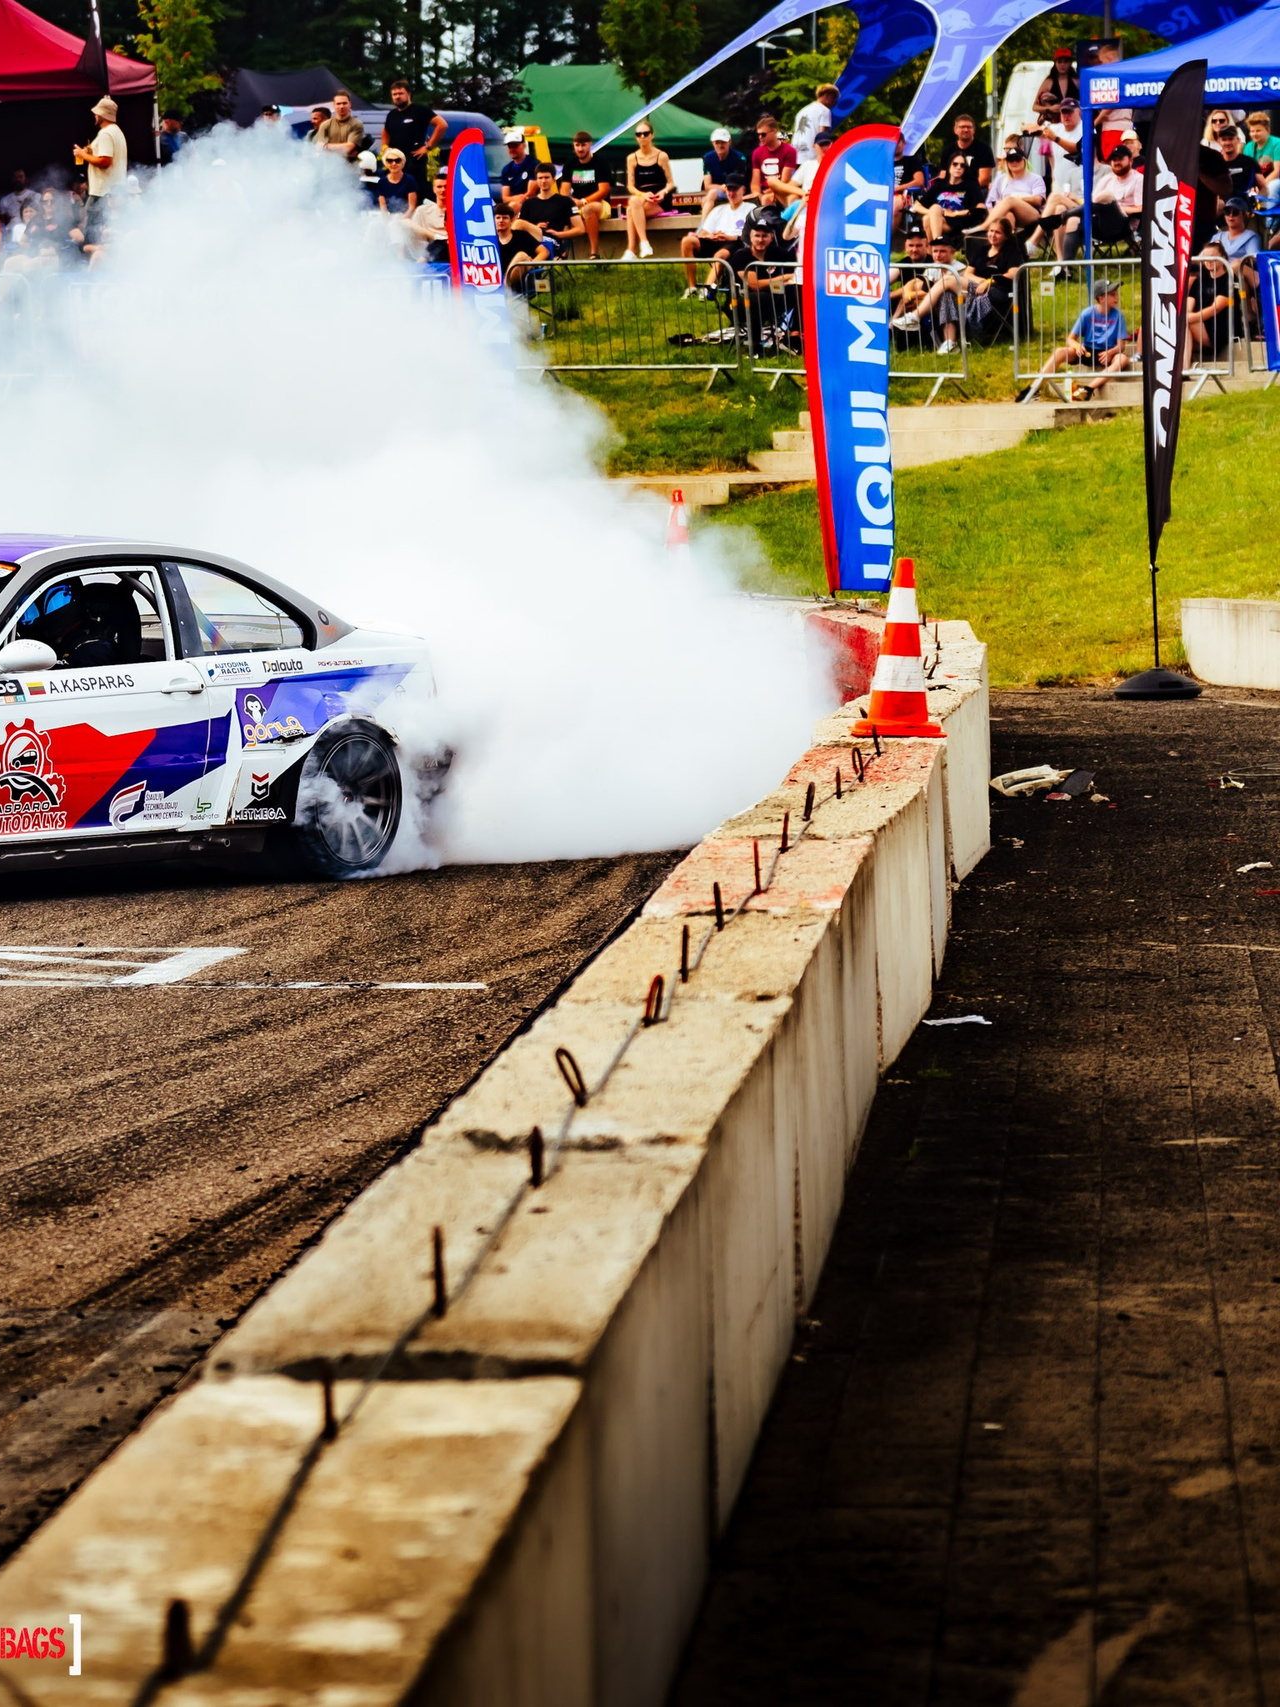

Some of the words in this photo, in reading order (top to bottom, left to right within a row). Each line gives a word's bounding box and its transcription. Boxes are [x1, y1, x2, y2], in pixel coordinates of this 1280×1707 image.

[1092, 80, 1118, 91] LIQUI
[1092, 91, 1119, 103] MOLY
[1176, 194, 1193, 271] TEAM
[828, 251, 879, 274] LIQUI
[828, 273, 880, 296] MOLY
[850, 389, 895, 582] LIQUI
[214, 661, 250, 670] AUTODINA
[221, 667, 252, 675] RACING
[262, 658, 304, 673] Dalauta
[50, 674, 135, 694] A.KASPARAS
[162, 811, 184, 820] CENTRAS
[234, 807, 287, 820] METMEGA
